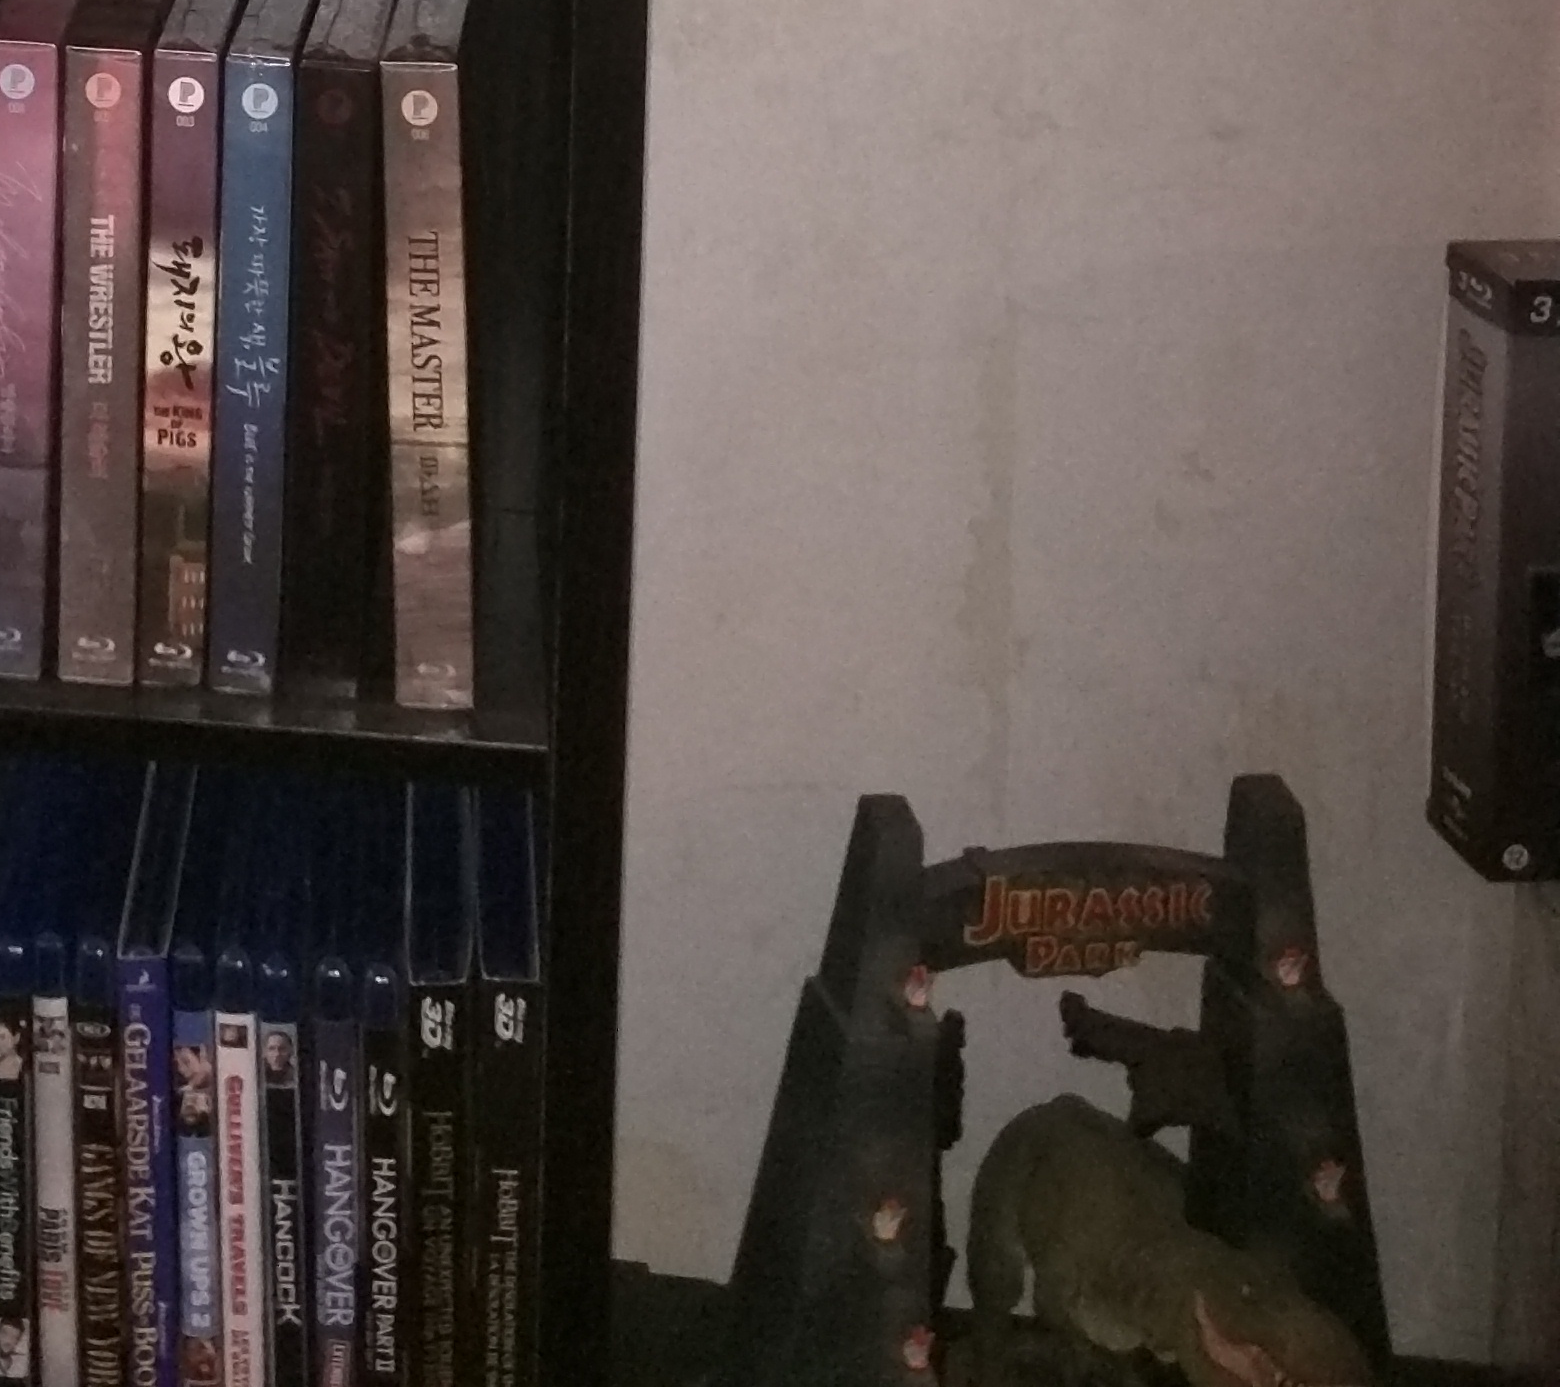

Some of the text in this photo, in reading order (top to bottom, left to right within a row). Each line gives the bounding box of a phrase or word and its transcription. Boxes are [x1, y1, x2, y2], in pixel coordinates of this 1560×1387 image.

[89, 214, 115, 258] THE
[88, 263, 114, 384] WRESTLER
[152, 235, 205, 390] 돼지의 왕
[407, 231, 444, 432] THE MASTER
[1529, 295, 1553, 323] 3
[157, 428, 198, 448] PIGS
[172, 404, 203, 420] KING
[963, 875, 1213, 946] JURASSIC
[1025, 935, 1140, 974] PARK
[420, 995, 443, 1049] 3D
[494, 992, 515, 1041] 3D
[124, 1022, 154, 1183] GELAARSDE
[128, 1185, 157, 1242] KAT
[225, 1075, 248, 1316] GULLIVER'S TRAVELS
[185, 1150, 211, 1328] GROWN UPS 2
[271, 1178, 303, 1327] HANCOCK
[322, 1144, 356, 1327] HANGOVER
[371, 1157, 398, 1373] HANGOVER PART II
[131, 1251, 157, 1316] PUSS
